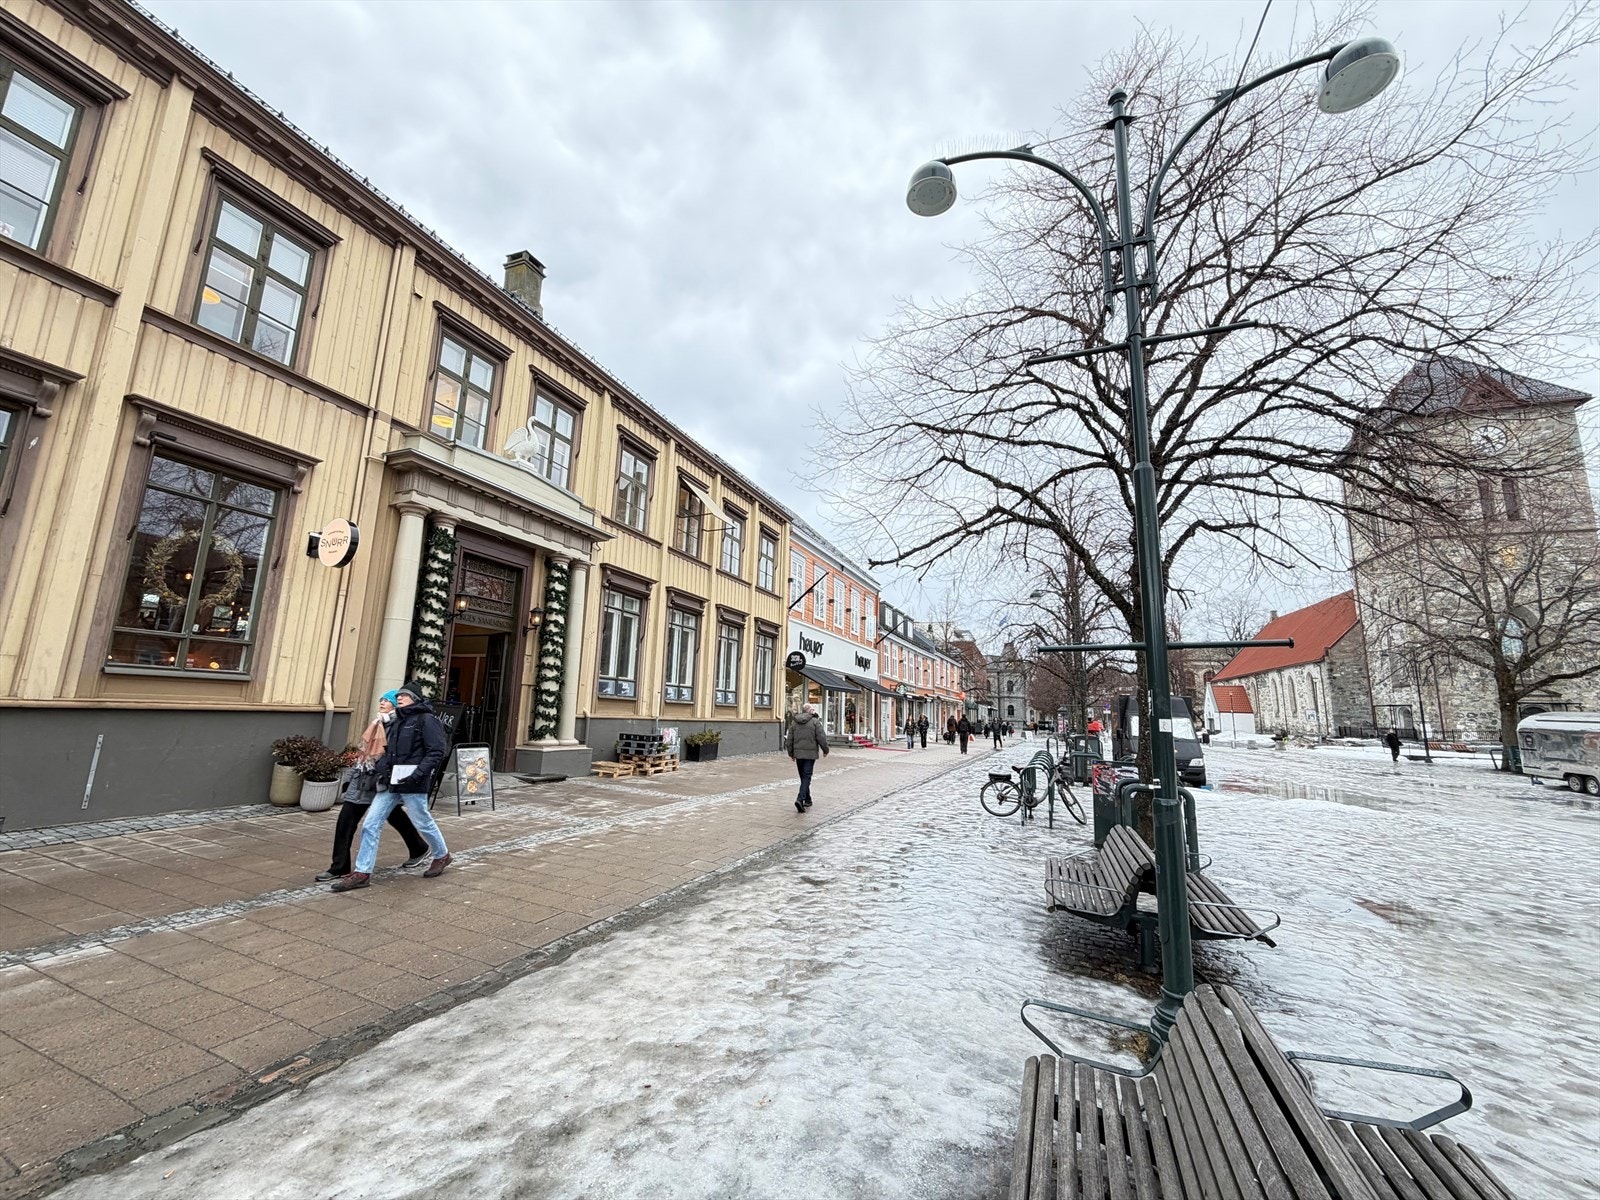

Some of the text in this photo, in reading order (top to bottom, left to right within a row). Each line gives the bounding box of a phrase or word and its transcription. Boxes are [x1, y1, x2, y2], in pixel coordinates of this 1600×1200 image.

[320, 535, 349, 548] SNURR
[799, 631, 824, 658] høyer
[855, 650, 871, 672] høyer
